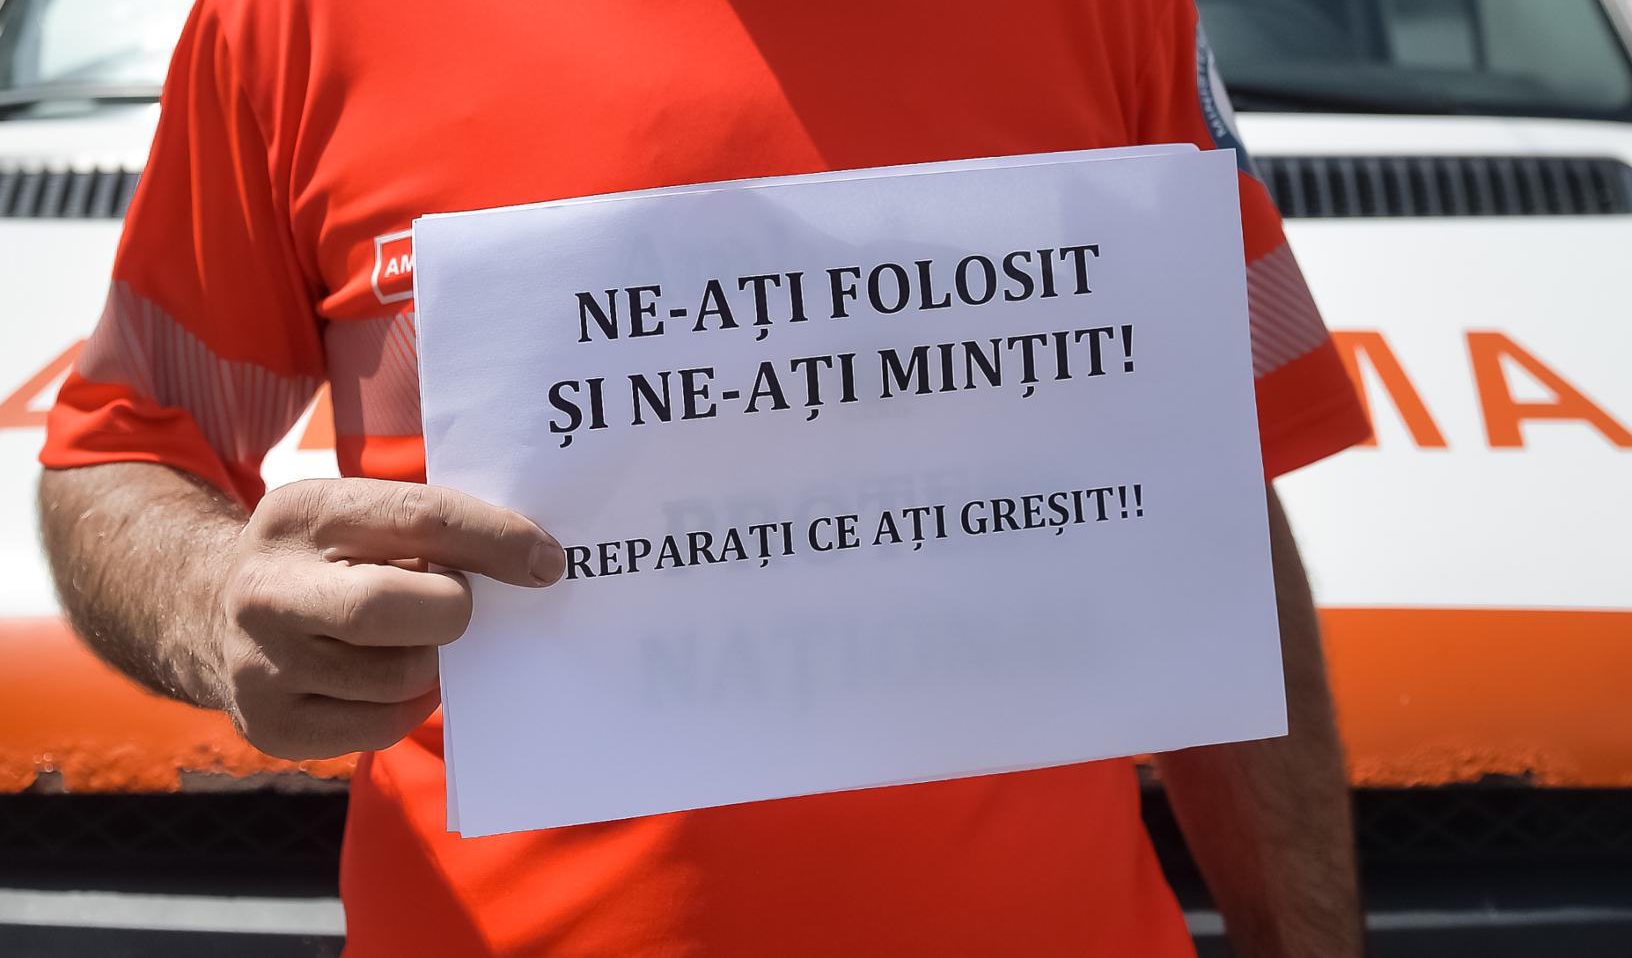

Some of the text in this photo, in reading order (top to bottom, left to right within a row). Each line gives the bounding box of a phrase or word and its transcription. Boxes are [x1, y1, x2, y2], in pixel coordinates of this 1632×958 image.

[574, 244, 1100, 343] NE-AȚI FOLOSIT
[548, 323, 1134, 449] ȘI NE-AȚI MINȚIT!
[564, 484, 1144, 580] REPARAȚI CE AȚI GREȘIT!!
